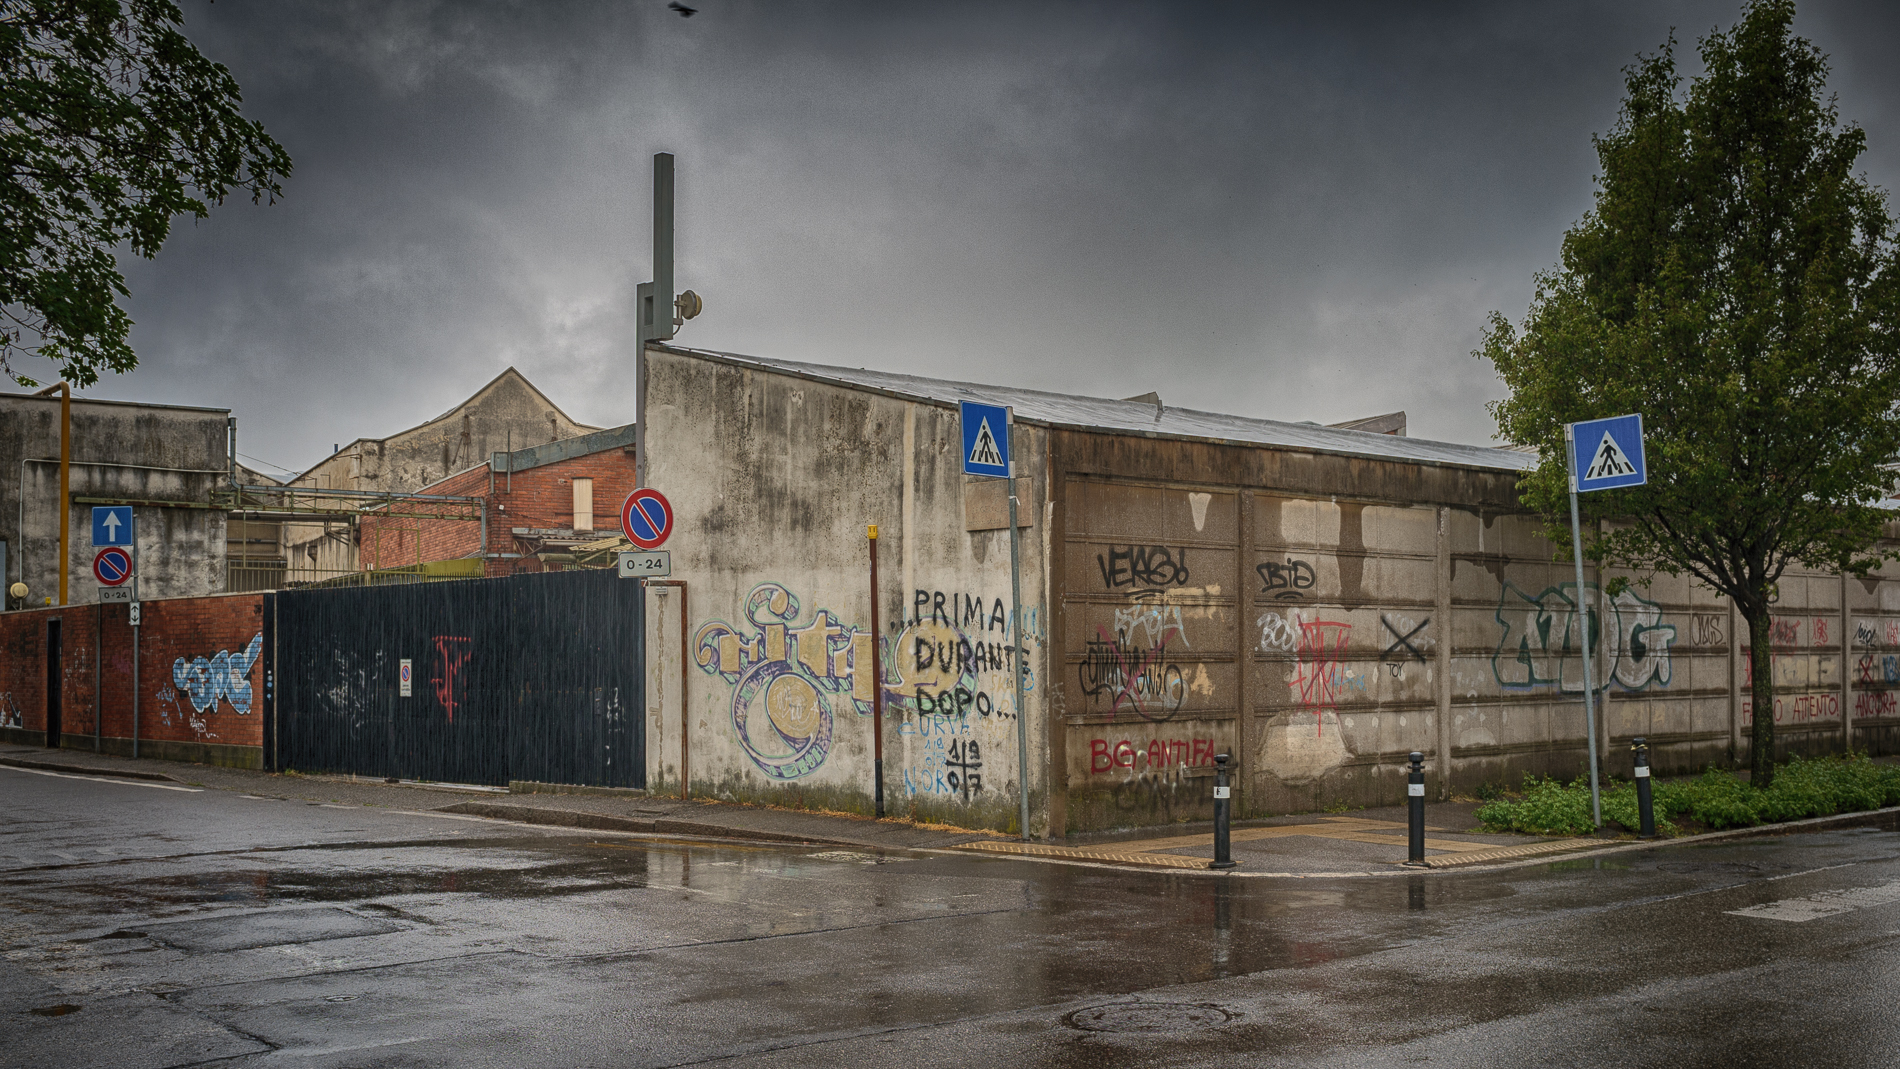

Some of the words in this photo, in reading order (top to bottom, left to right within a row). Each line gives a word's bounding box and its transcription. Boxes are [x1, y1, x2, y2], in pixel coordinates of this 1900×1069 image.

[627, 560, 635, 569] 0
[645, 559, 662, 569] 24
[115, 591, 127, 599] 24
[1148, 738, 1215, 768] ANTIFA
